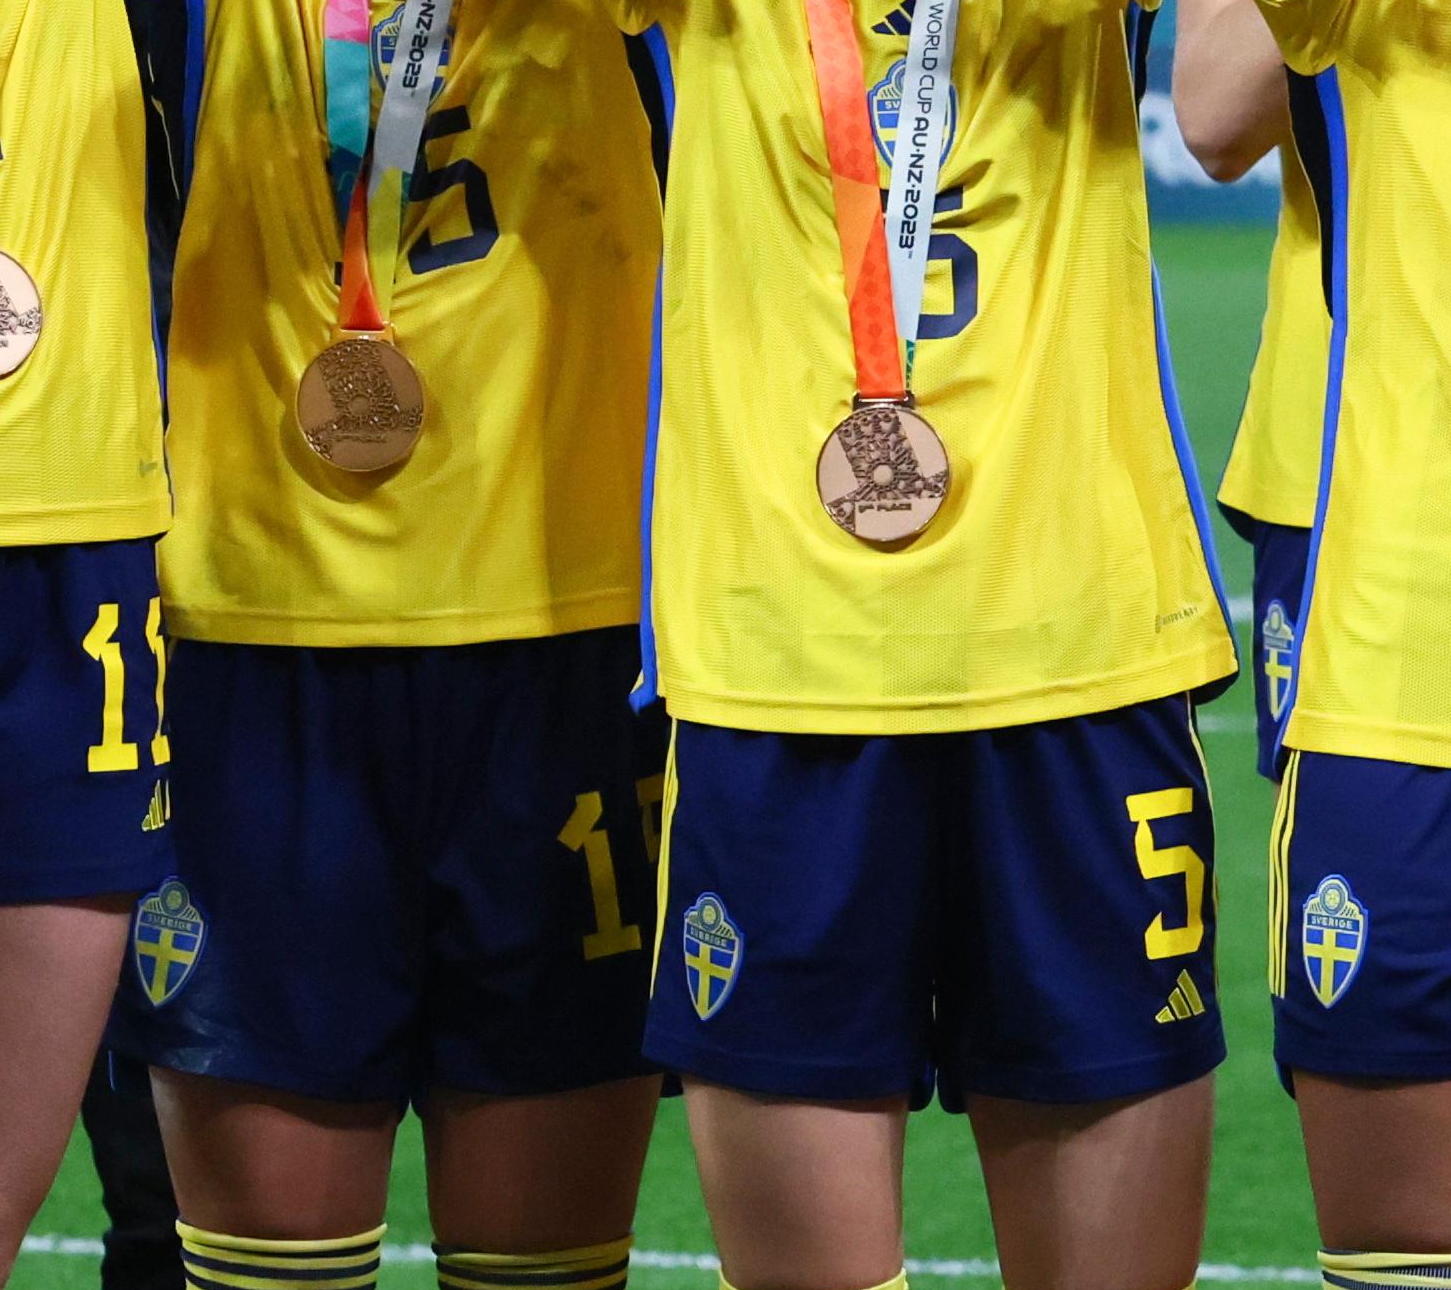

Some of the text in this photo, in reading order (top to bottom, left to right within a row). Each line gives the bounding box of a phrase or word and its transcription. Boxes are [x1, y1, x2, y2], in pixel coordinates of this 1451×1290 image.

[922, 3, 943, 71] WORLD
[917, 75, 935, 115] CUP
[1126, 787, 1205, 960] 5
